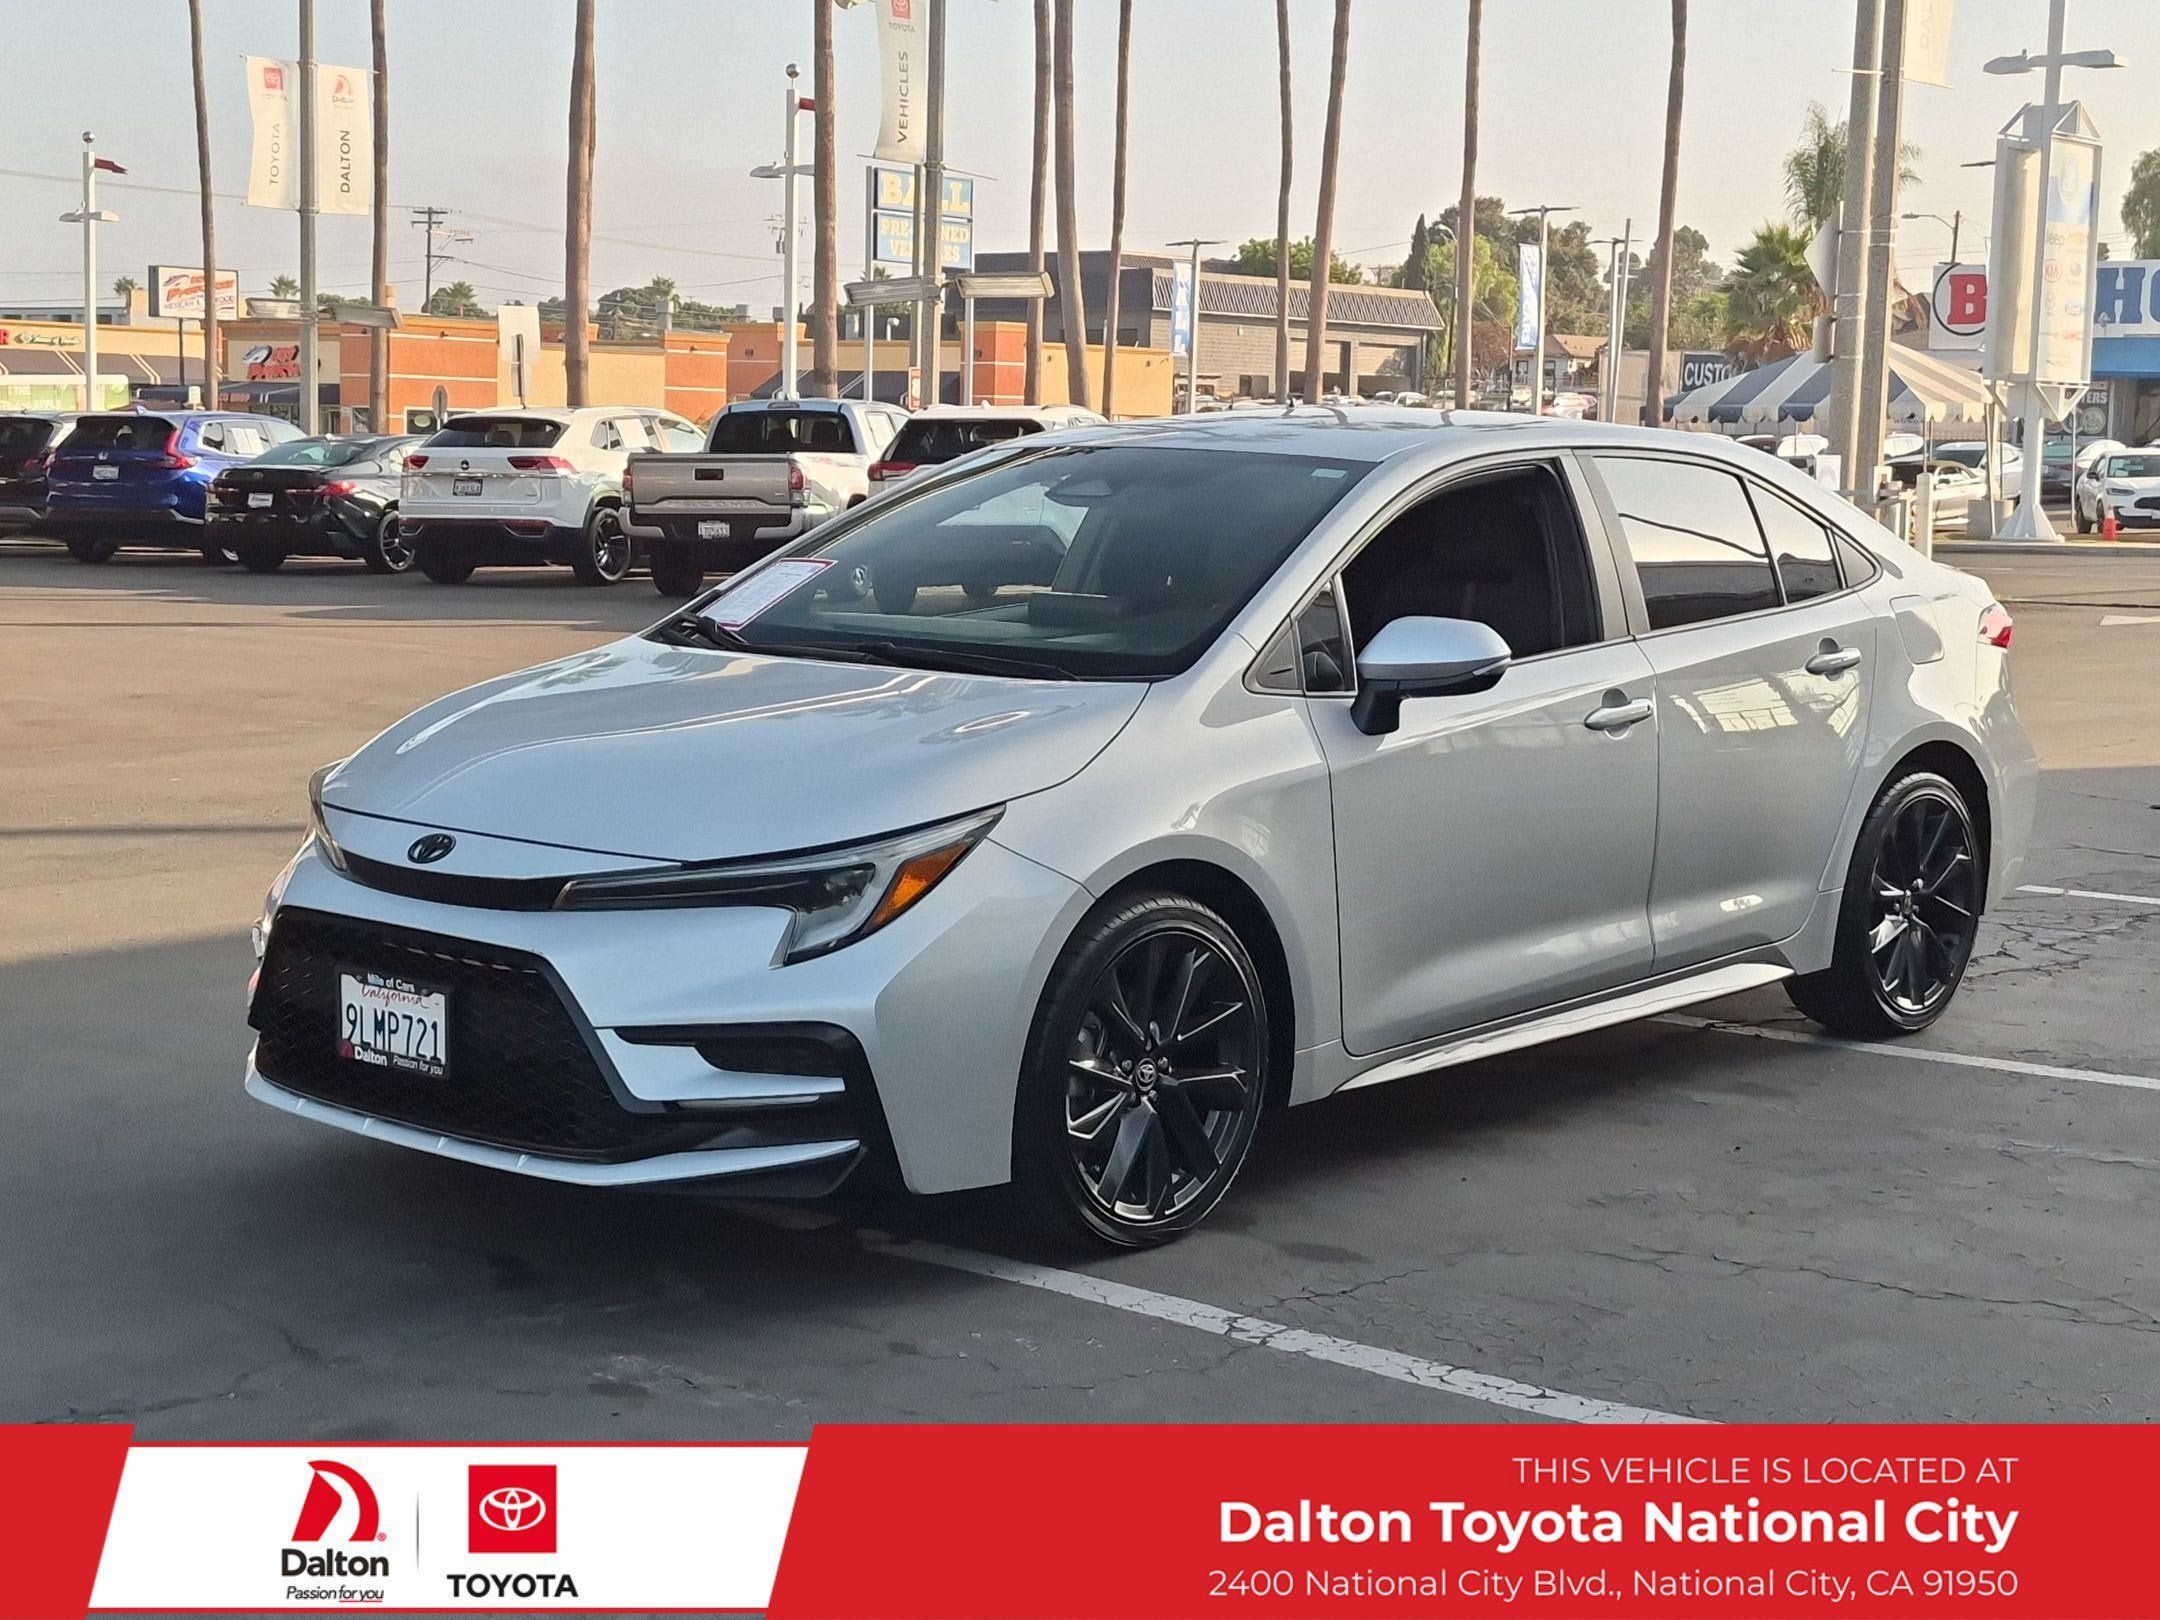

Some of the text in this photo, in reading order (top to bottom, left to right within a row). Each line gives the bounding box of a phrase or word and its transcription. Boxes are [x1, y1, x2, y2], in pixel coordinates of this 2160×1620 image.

[889, 22, 915, 33] TOYOTA
[898, 51, 909, 143] VEHICLES
[269, 123, 281, 186] TOYOTA
[340, 130, 351, 193] DALTON
[1947, 274, 1987, 325] B
[386, 978, 394, 989] of
[396, 979, 415, 993] Cars
[346, 1003, 442, 1061] 9LMP721
[354, 1046, 443, 1075] Dalton Passion for you
